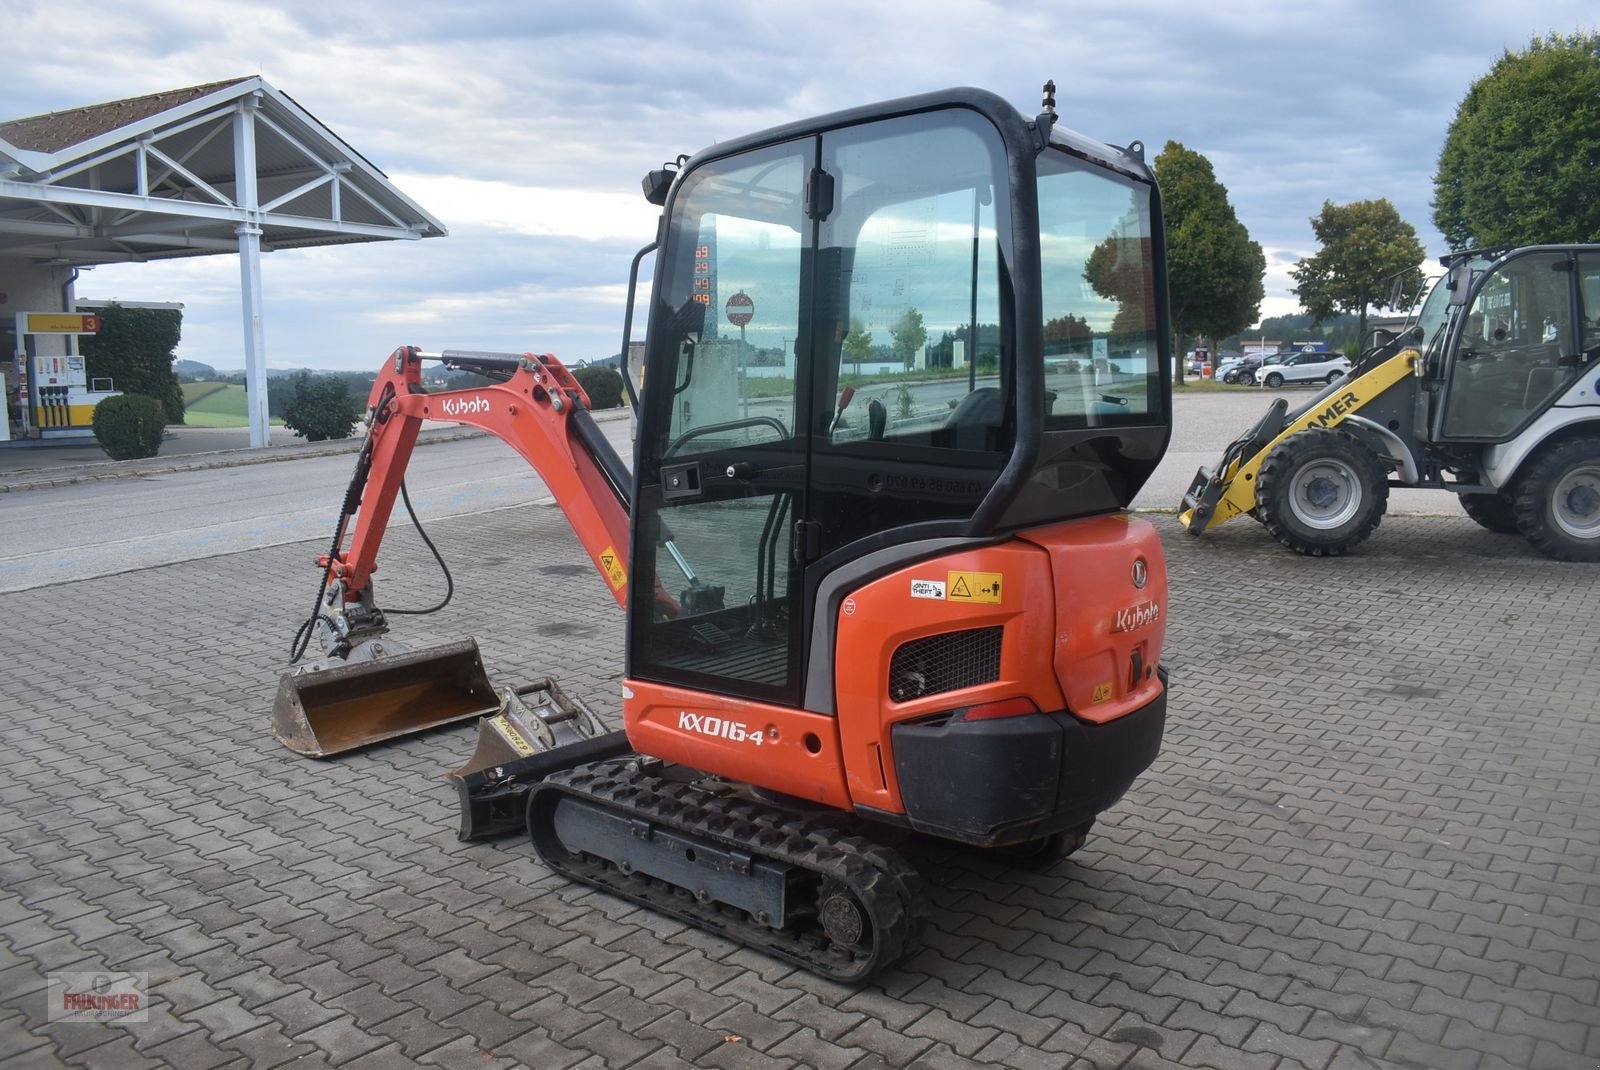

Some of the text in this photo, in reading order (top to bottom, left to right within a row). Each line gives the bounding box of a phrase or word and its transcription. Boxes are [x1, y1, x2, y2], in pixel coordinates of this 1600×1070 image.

[695, 263, 708, 273] 29
[87, 318, 95, 329] 3
[442, 395, 490, 415] Kubota
[1116, 600, 1159, 632] Kubota
[679, 711, 764, 746] KX016-4
